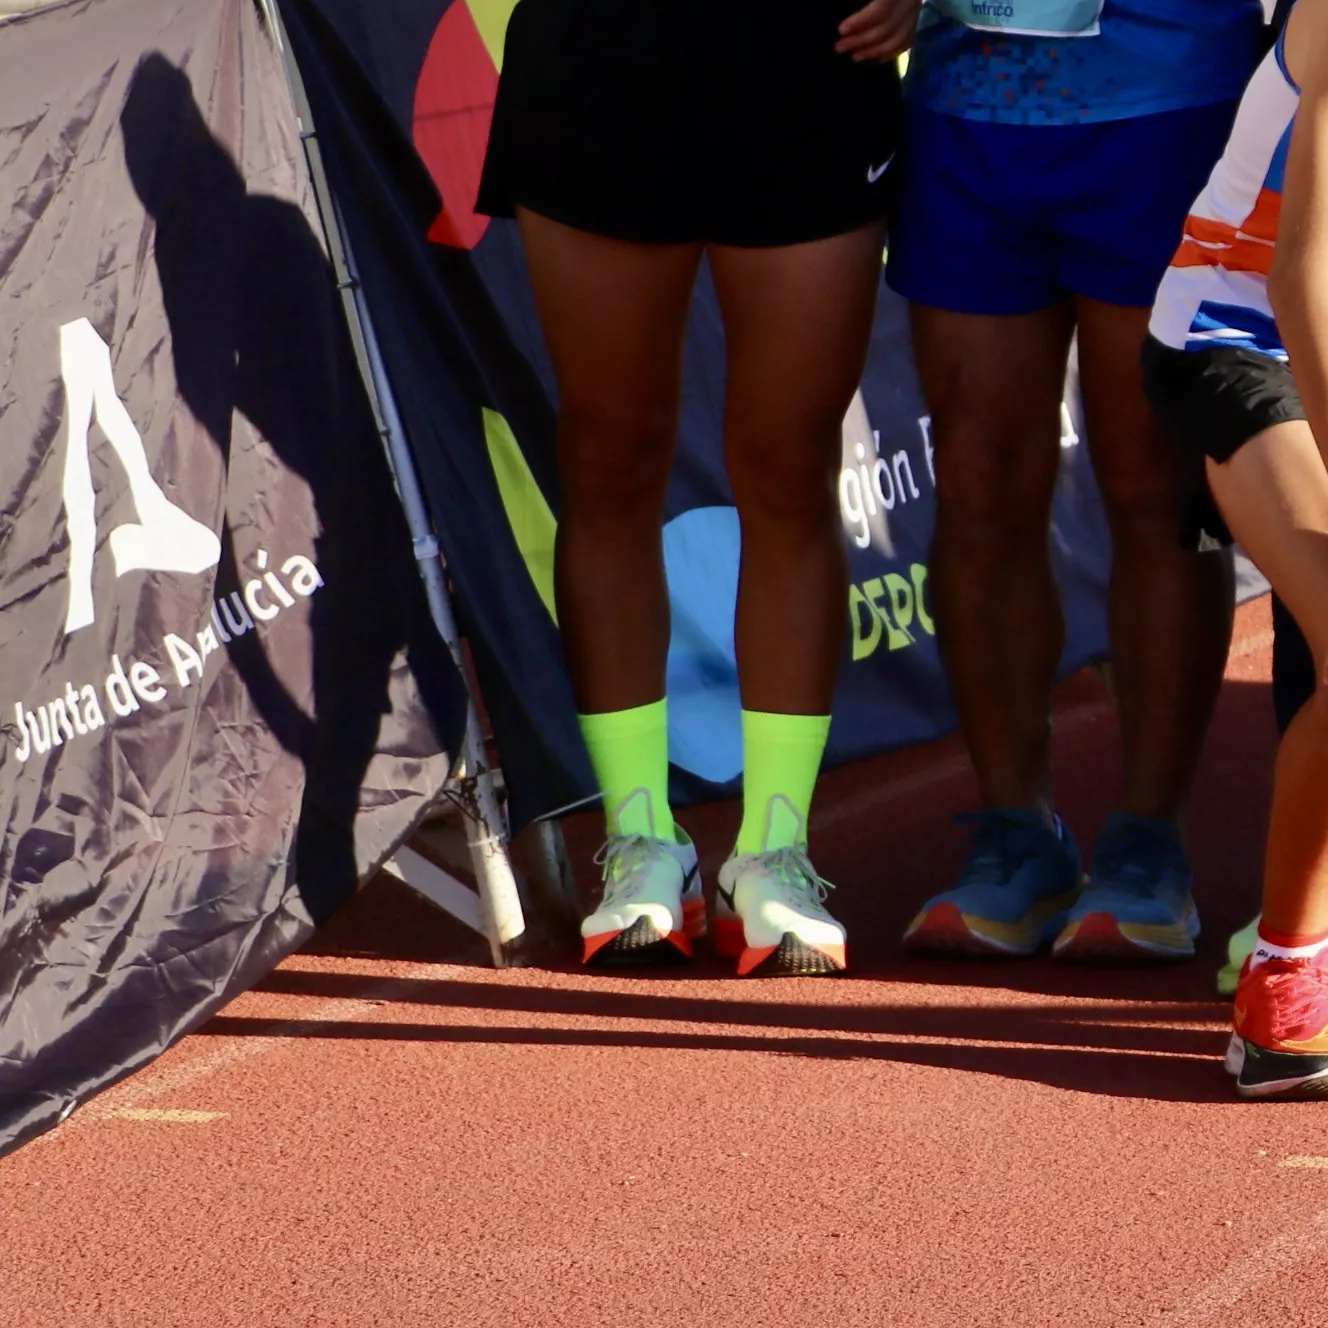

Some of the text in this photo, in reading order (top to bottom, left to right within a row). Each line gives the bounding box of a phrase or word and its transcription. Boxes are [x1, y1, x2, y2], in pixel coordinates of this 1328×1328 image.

[971, 0, 1014, 17] Infrico
[14, 681, 106, 763] Junta
[105, 654, 168, 718] de
